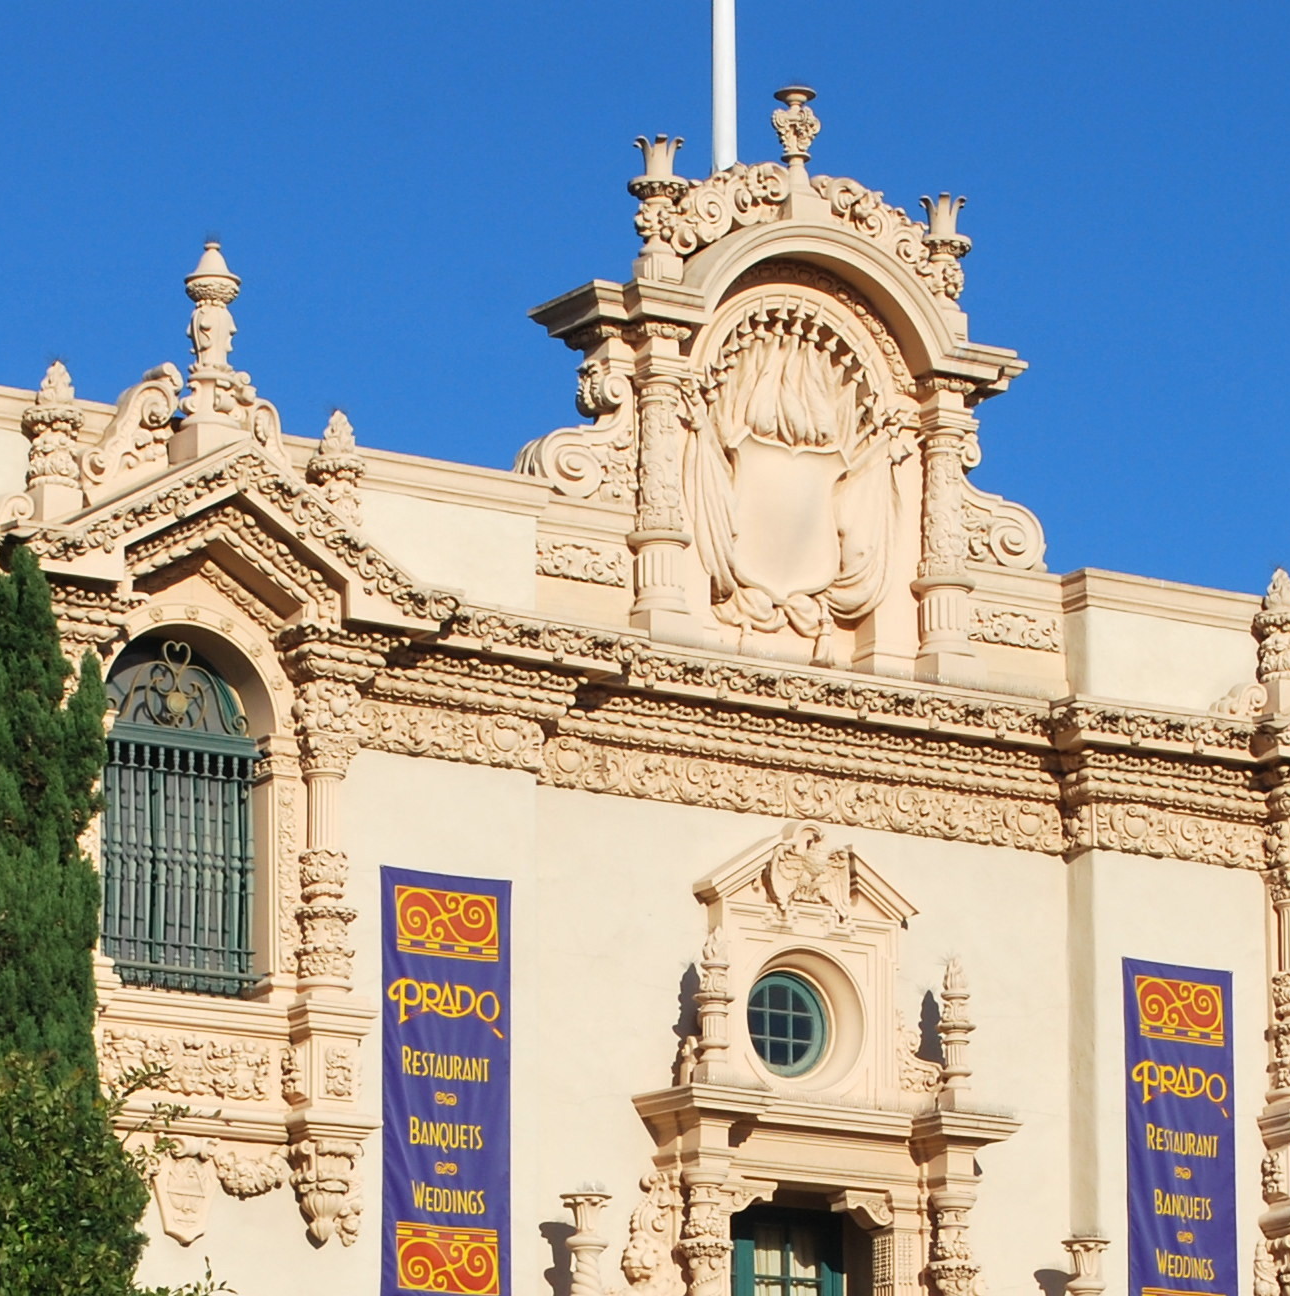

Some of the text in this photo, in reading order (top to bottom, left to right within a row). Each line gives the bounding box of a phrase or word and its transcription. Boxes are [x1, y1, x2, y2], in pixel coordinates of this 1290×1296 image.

[387, 978, 501, 1025] PRADO
[401, 1045, 490, 1082] RESTAURANT
[1131, 1060, 1227, 1104] PRADO
[409, 1116, 484, 1153] BANQUETS
[1145, 1122, 1219, 1158] RESTAURANT
[411, 1180, 486, 1215] WEDDINGS
[1154, 1188, 1213, 1223] BANQUETS
[1155, 1248, 1215, 1281] WEDDINGS
